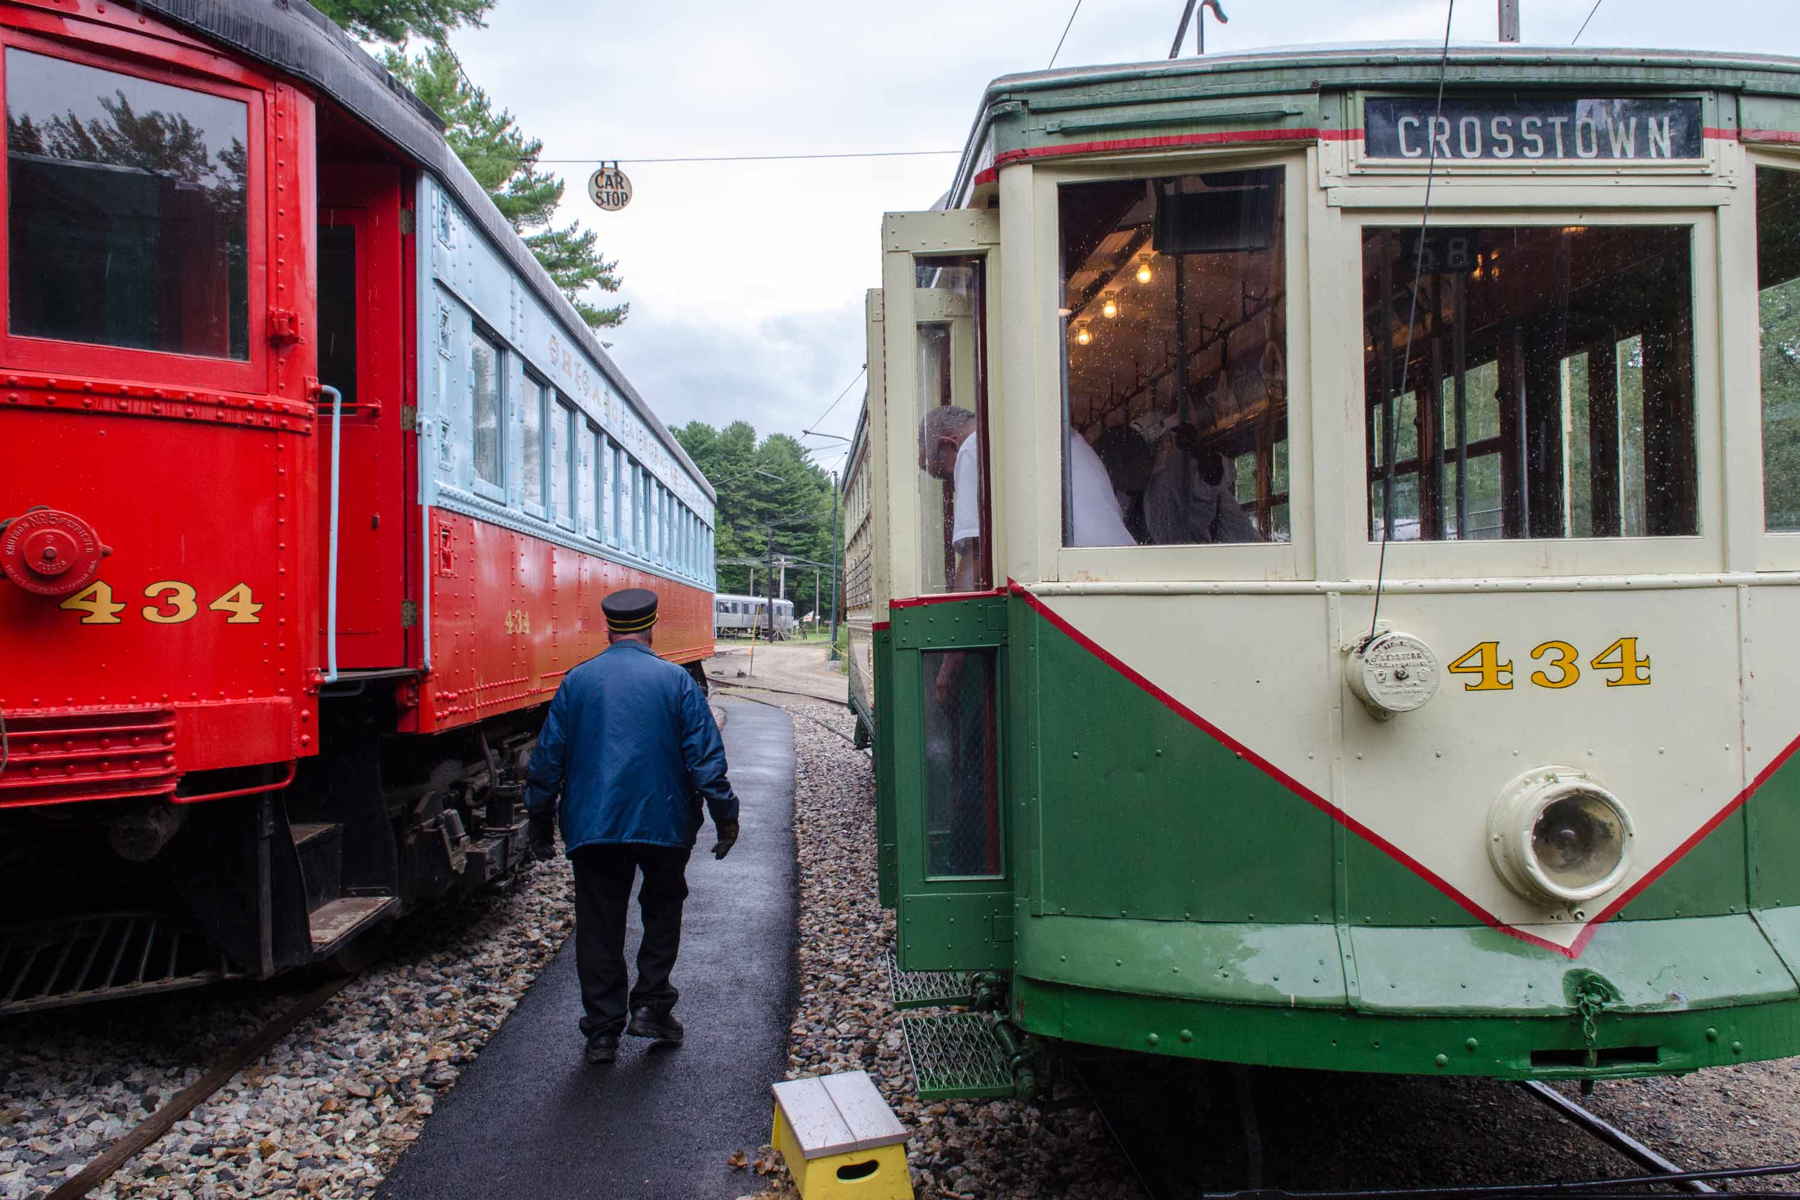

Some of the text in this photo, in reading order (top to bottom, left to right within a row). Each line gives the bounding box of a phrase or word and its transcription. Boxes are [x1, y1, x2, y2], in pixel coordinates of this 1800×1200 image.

[1397, 116, 1672, 159] CROSSTOWN
[595, 172, 624, 190] CAR
[595, 191, 629, 206] STOP
[58, 580, 265, 625] 434
[1447, 637, 1652, 692] 434
